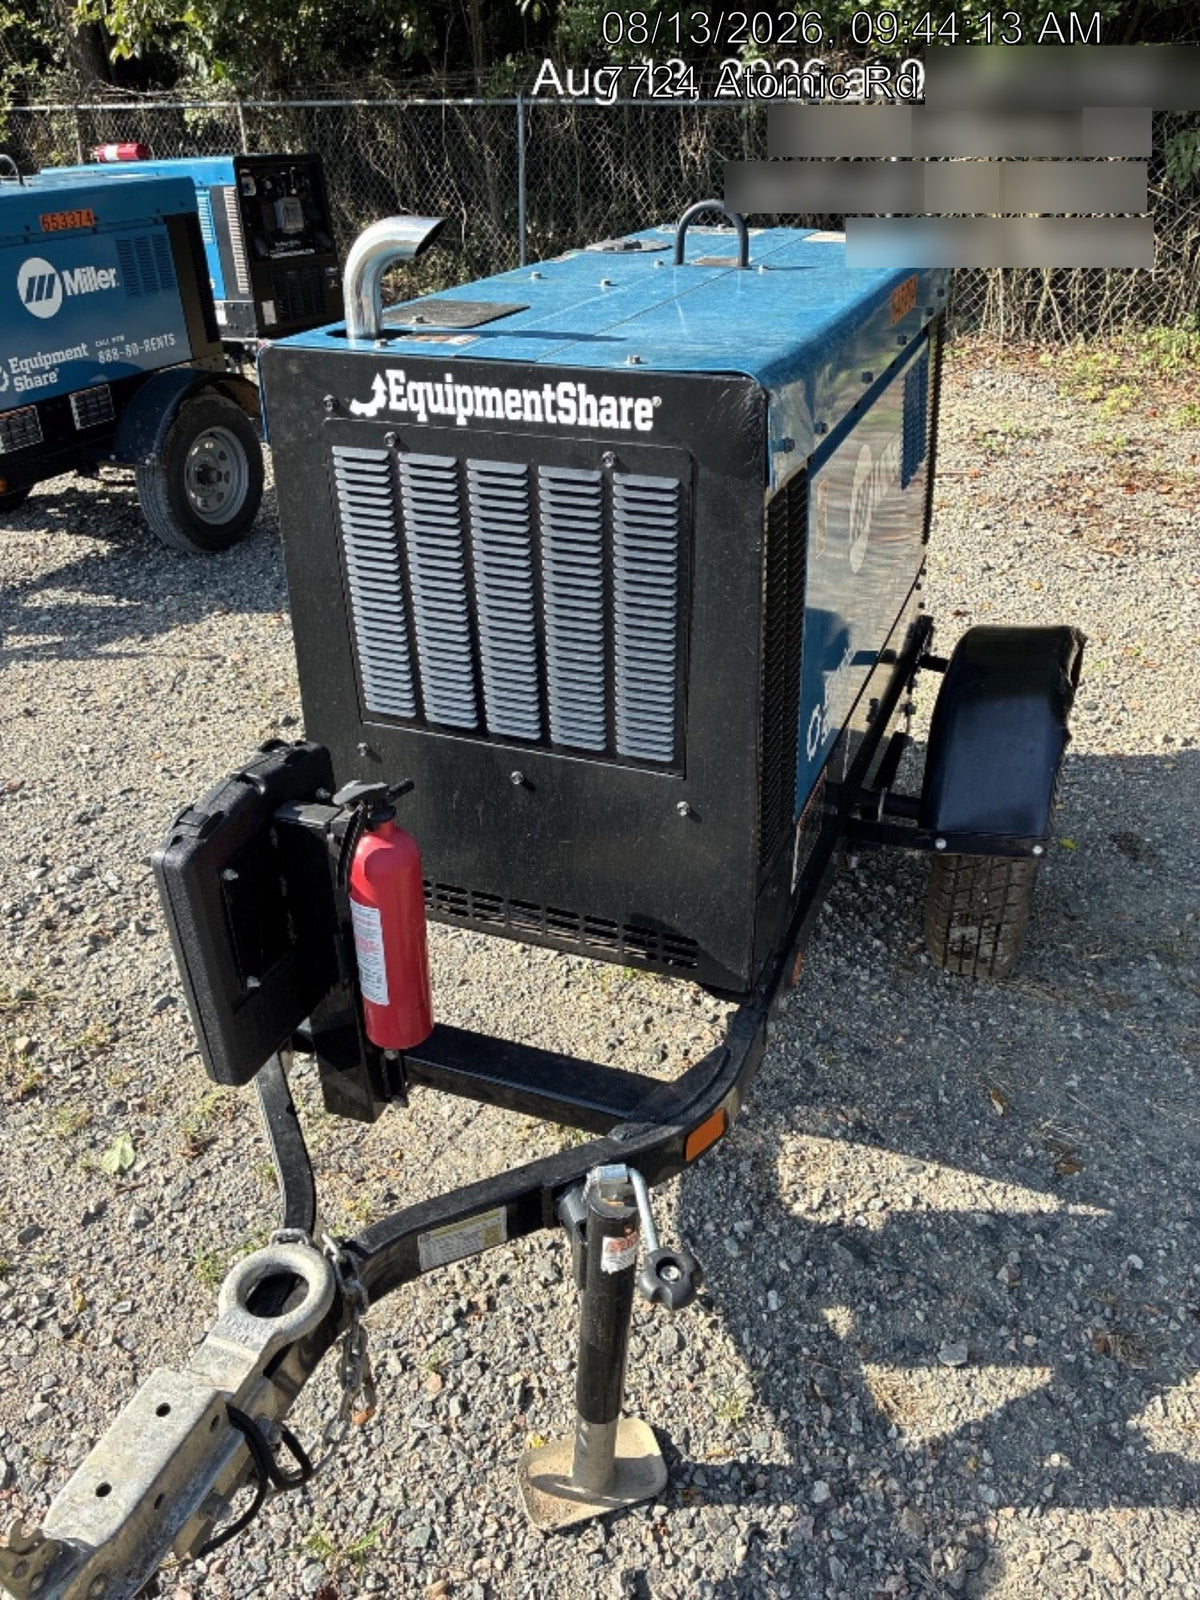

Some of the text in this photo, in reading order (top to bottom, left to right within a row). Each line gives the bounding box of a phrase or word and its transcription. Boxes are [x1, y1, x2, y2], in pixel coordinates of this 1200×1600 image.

[61, 266, 117, 296] Miller
[8, 342, 90, 374] Equipment
[13, 371, 58, 392] Share
